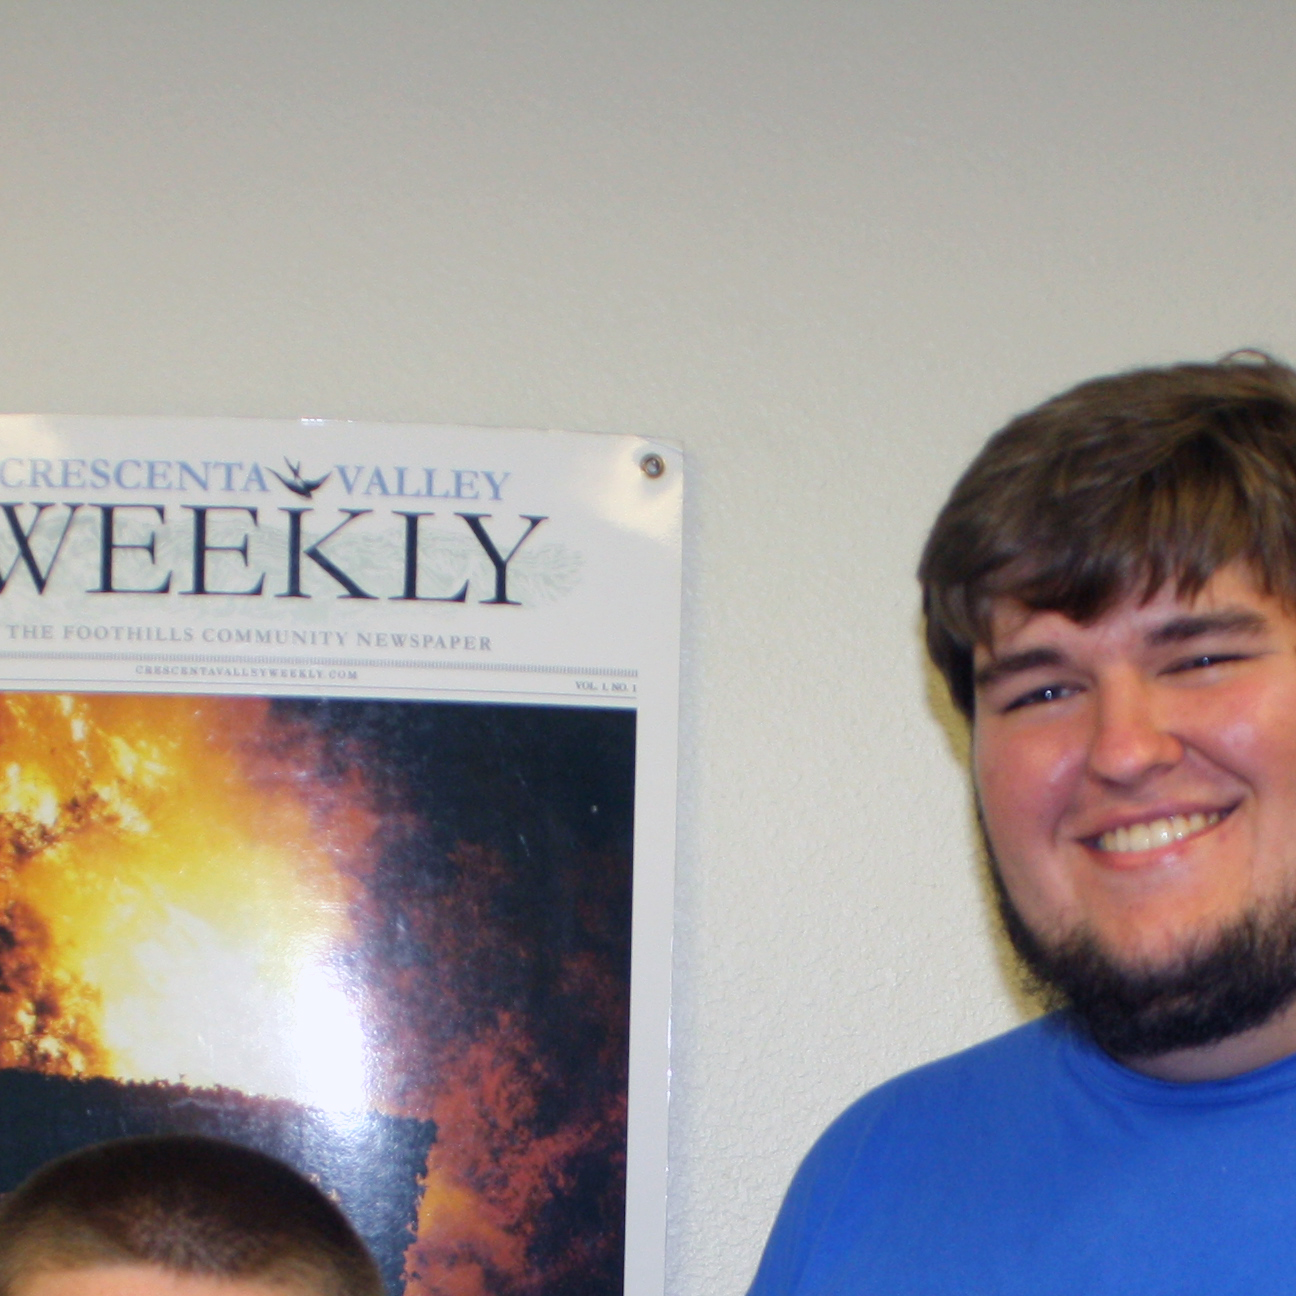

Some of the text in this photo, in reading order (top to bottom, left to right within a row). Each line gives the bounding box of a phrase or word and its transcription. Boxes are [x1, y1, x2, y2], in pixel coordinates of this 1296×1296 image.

[334, 464, 510, 501] VALLEY
[5, 624, 492, 651] THE FOOTHILLS COMMUNITY NEWSPAPER
[575, 681, 598, 691] VOL.
[611, 683, 629, 692] NO.
